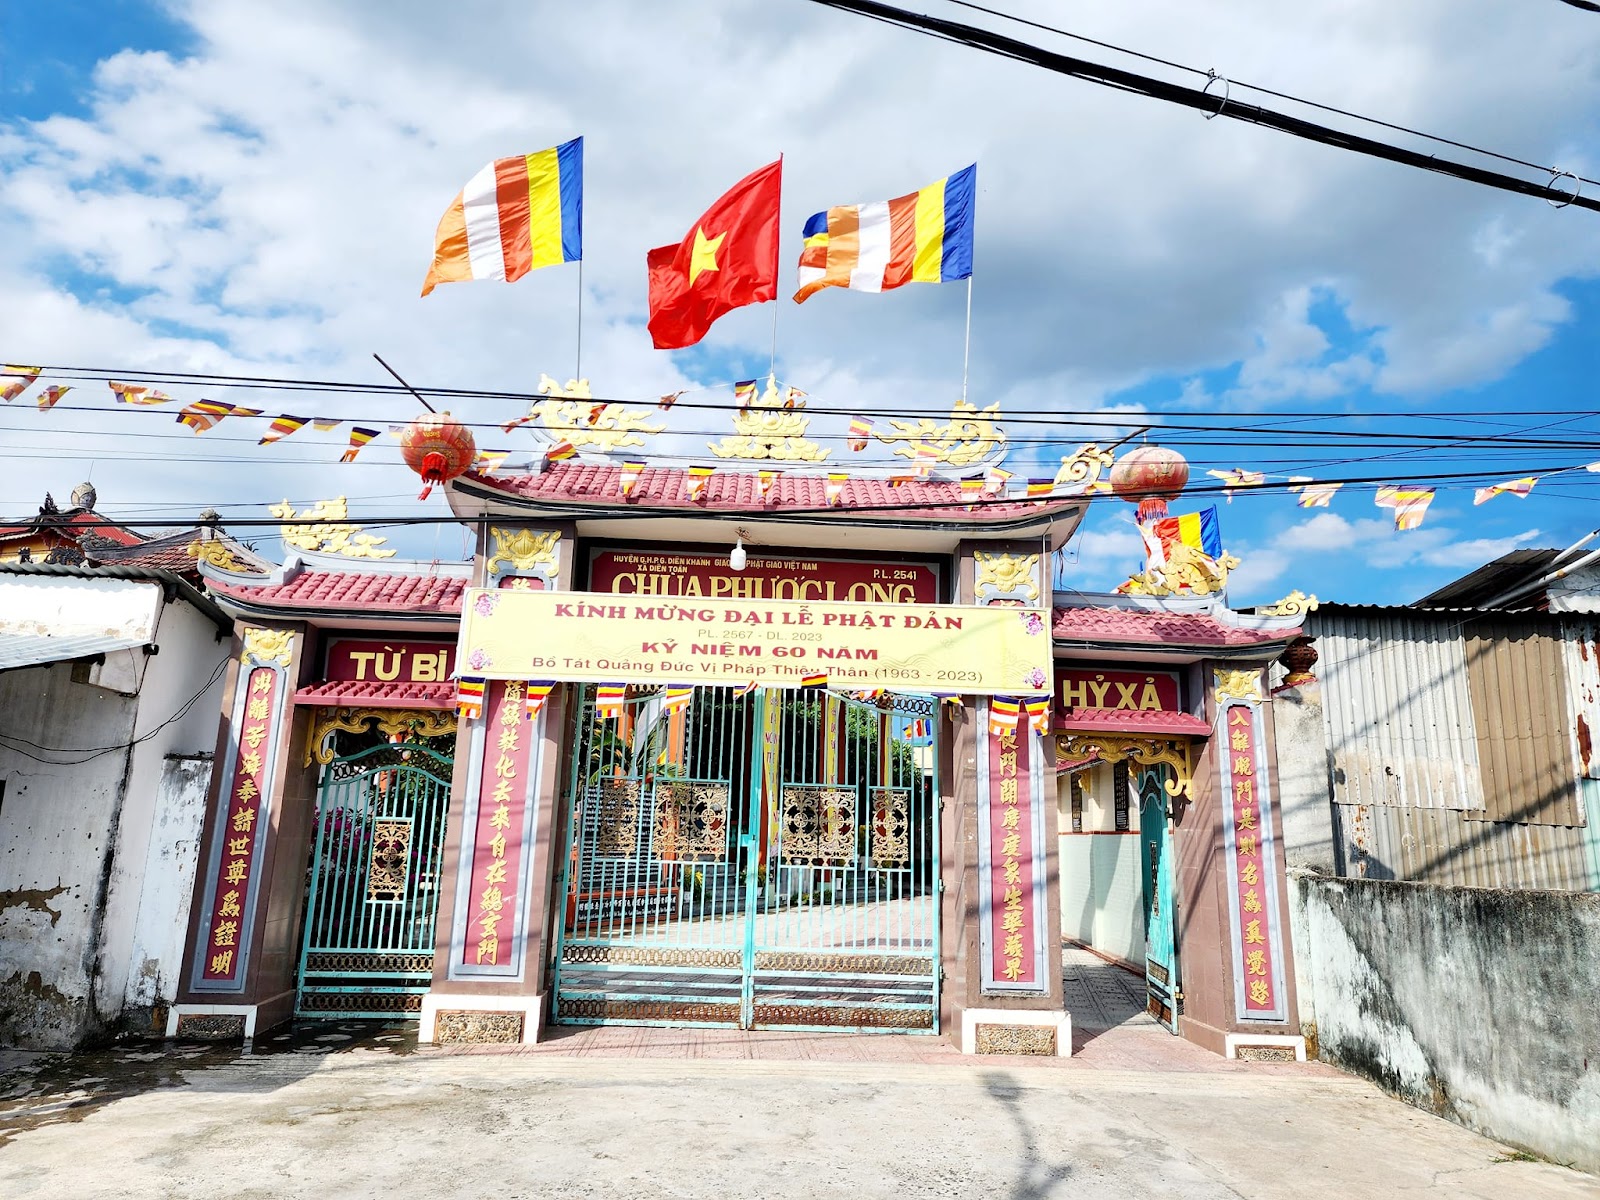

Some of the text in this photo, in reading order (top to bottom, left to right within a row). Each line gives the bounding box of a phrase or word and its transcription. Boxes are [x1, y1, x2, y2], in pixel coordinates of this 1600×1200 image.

[802, 562, 818, 571] NAM
[894, 570, 917, 580] 2541
[554, 601, 963, 630] KÍNH MỪNG ĐẠI LỄ PHẬT ĐẢN
[698, 628, 718, 639] PL.
[722, 630, 754, 640] 2567
[766, 631, 788, 641] DL.
[791, 632, 823, 642] 2023
[642, 638, 878, 661] KỶ NIỆM 60 NĂM
[350, 646, 407, 681] TỪ
[563, 658, 591, 669] Tát
[596, 659, 654, 673] Quảng
[661, 661, 694, 672] Đức
[701, 662, 716, 675] Vị
[722, 663, 767, 676] Pháp
[826, 666, 868, 677] Thân
[874, 668, 920, 680] (1963
[937, 670, 983, 684] 2023)
[1062, 674, 1163, 712] HỶ XẢ
